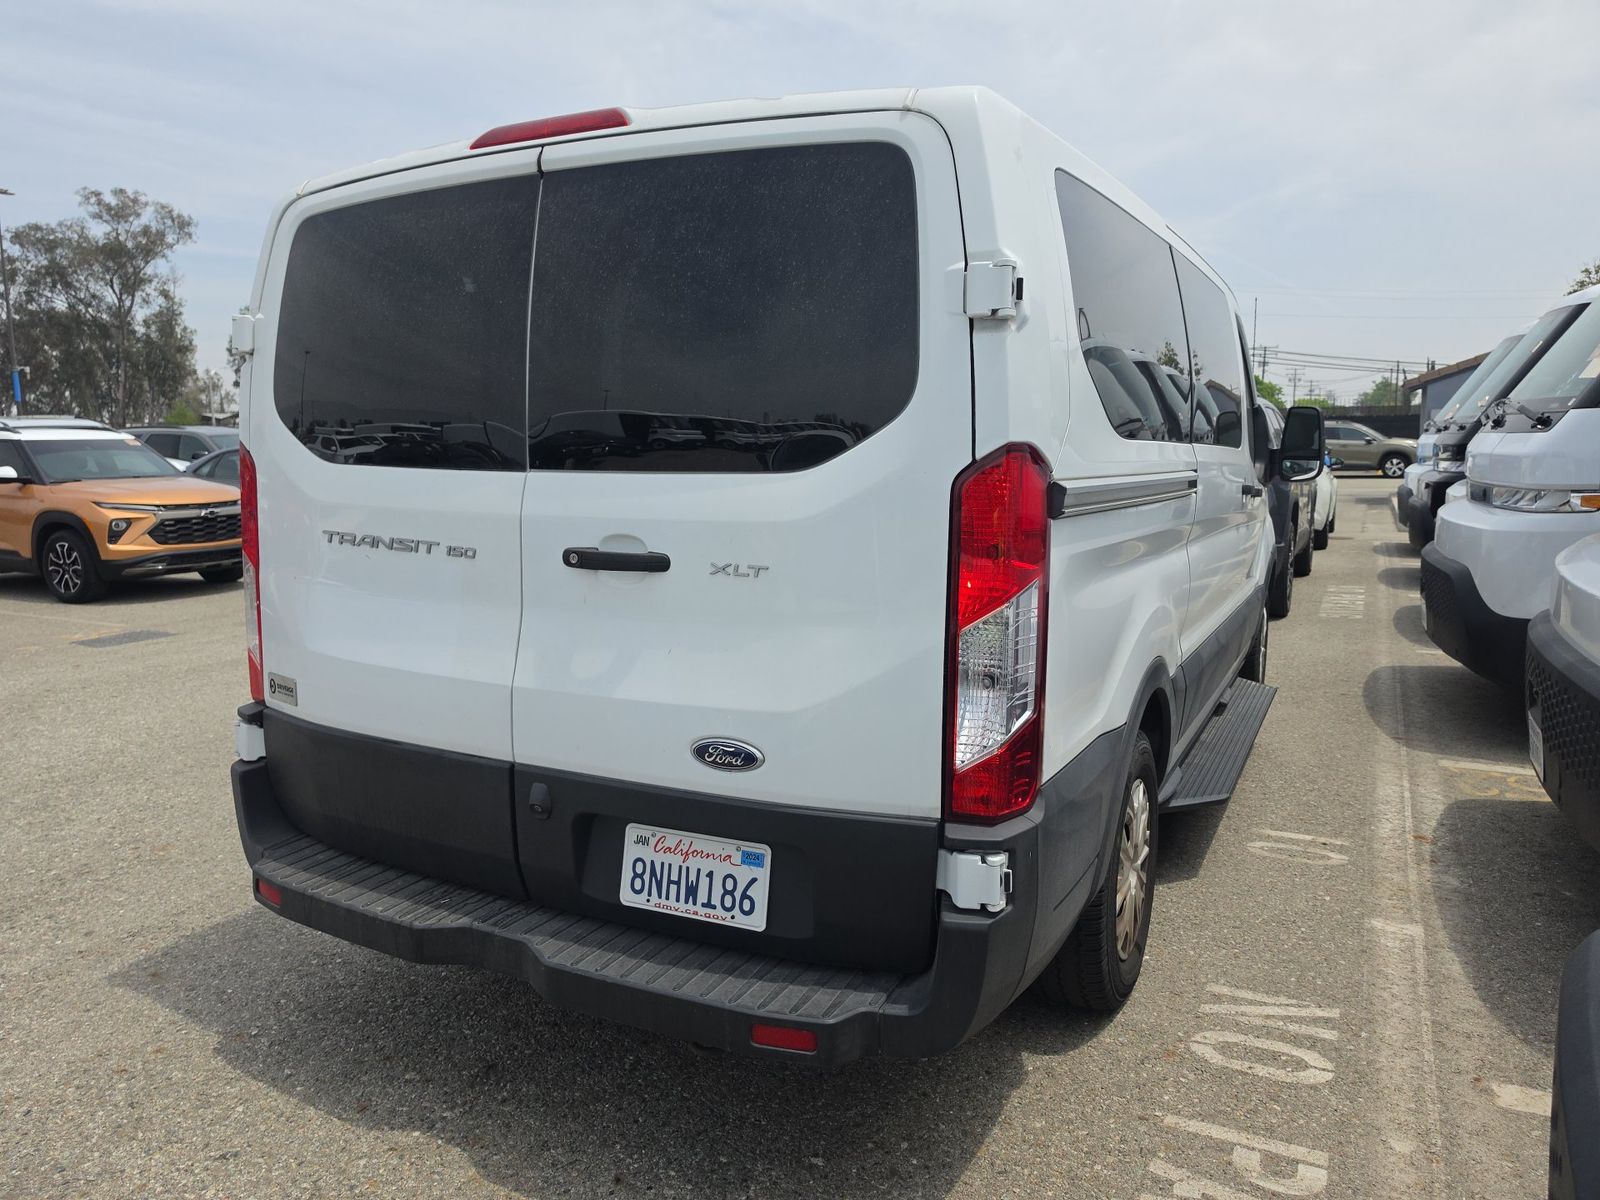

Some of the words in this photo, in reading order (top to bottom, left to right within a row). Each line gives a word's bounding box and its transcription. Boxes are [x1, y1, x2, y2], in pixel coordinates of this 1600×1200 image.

[322, 530, 440, 554] TRANSIT
[446, 545, 477, 559] 150
[709, 562, 769, 578] XLT
[704, 744, 744, 765] Ford
[633, 834, 650, 846] JAN
[653, 835, 742, 866] California
[745, 851, 760, 862] 2024
[630, 857, 758, 916] 8NHW186
[654, 901, 728, 921] dmv.ca.gov
[1190, 984, 1340, 1085] NO
